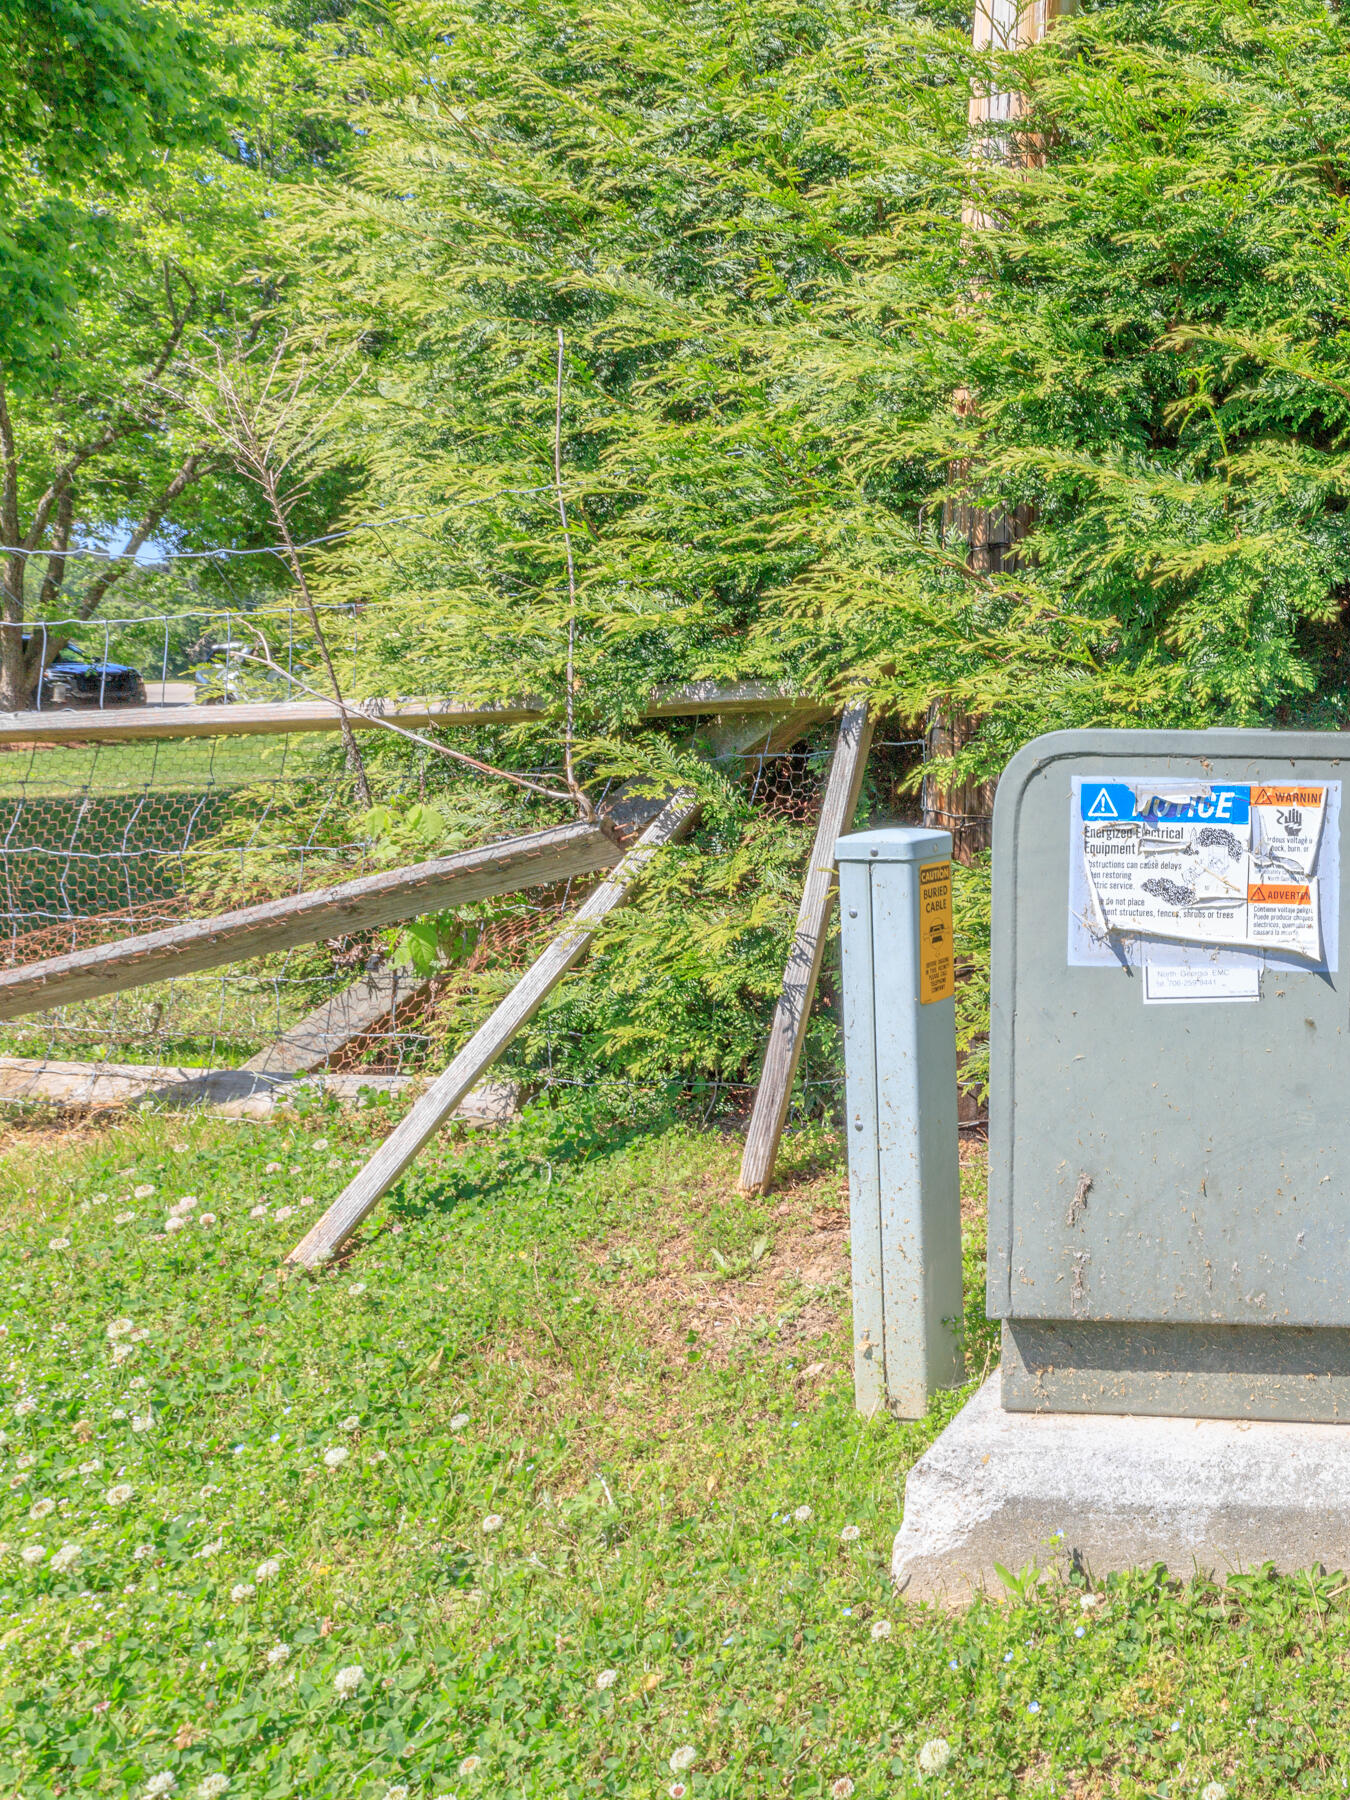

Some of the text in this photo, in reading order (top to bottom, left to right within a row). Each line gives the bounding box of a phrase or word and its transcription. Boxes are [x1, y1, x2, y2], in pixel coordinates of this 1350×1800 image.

[1084, 825, 1133, 841] Energized
[1084, 843, 1136, 857] Equipment
[1088, 860, 1125, 869] bstructions
[1140, 861, 1159, 869] cause
[1160, 861, 1182, 871] delays
[921, 868, 949, 882] CAUTION
[1102, 872, 1132, 881] restoring
[1109, 882, 1136, 890] service.
[923, 885, 948, 900] BURIED
[925, 898, 948, 914] CABLE
[1127, 898, 1145, 907] place
[1119, 908, 1155, 918] structures,
[1216, 911, 1234, 919] trees
